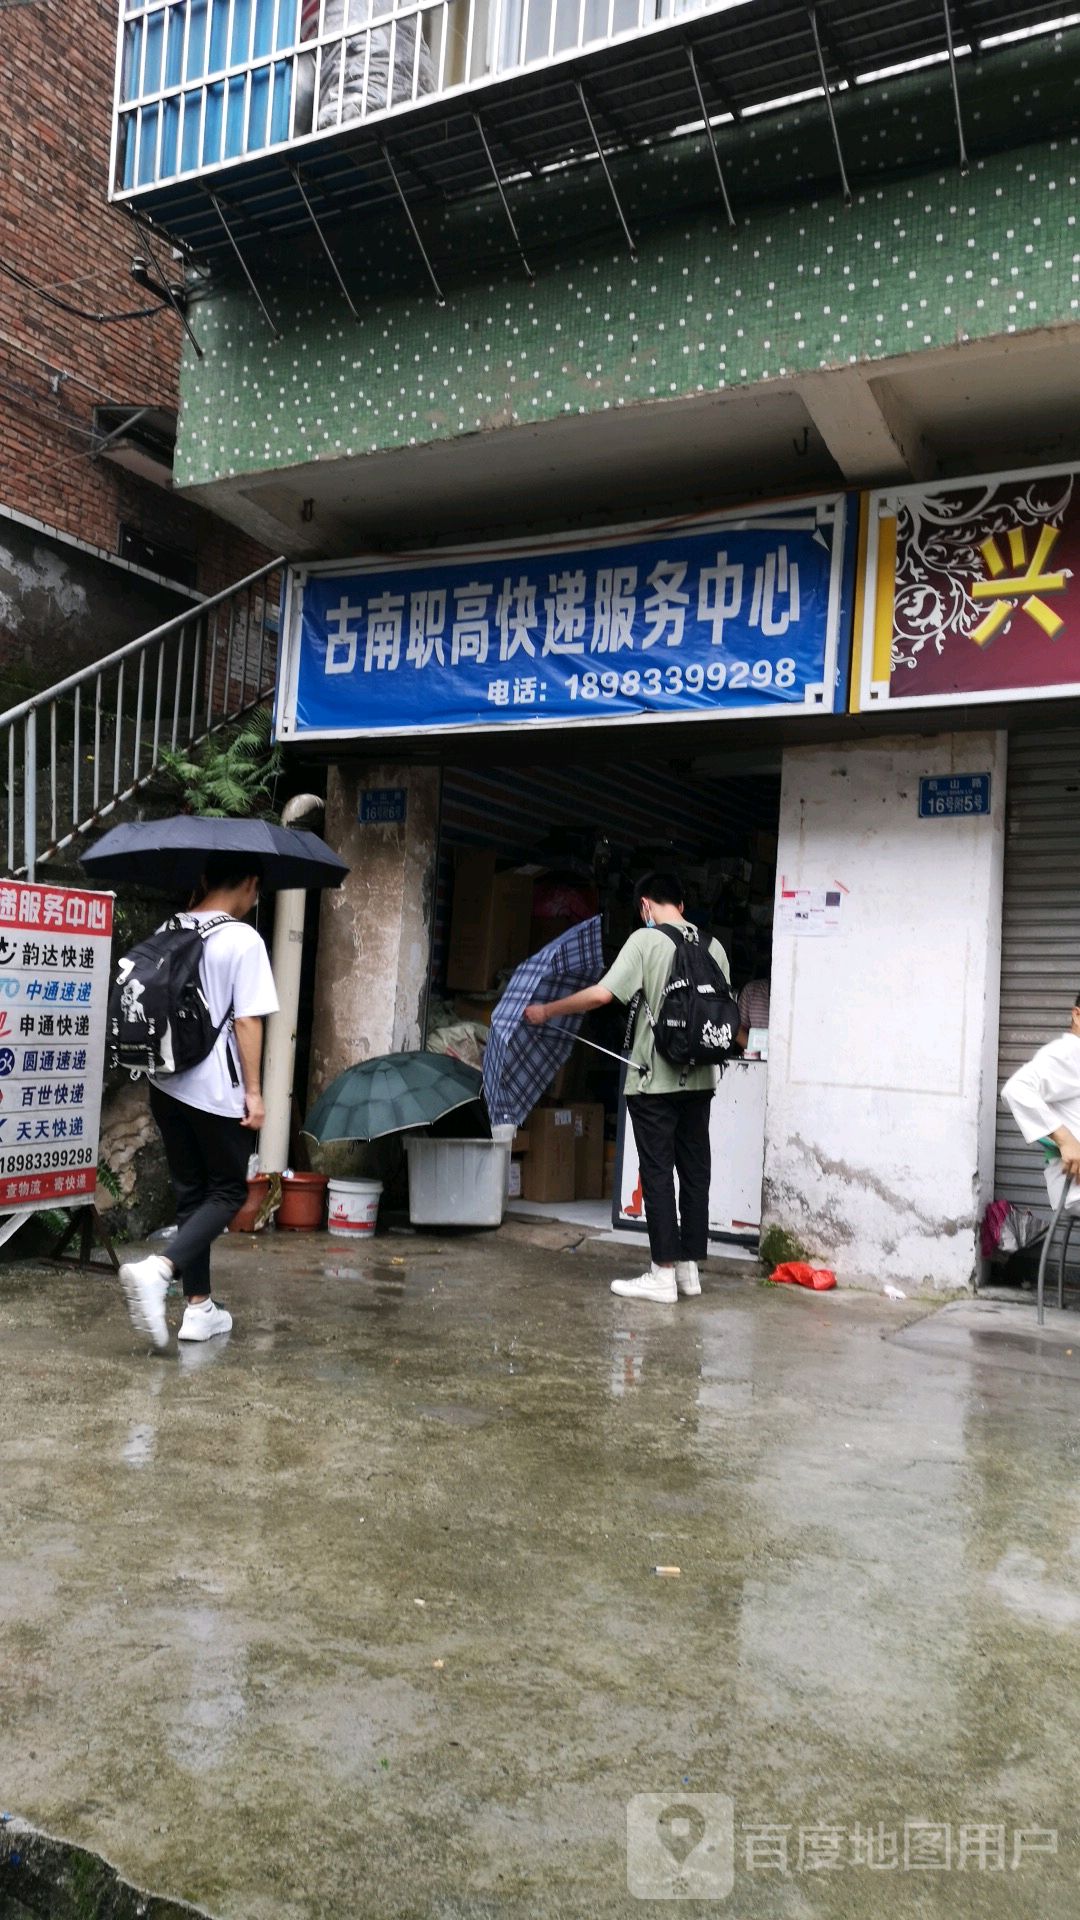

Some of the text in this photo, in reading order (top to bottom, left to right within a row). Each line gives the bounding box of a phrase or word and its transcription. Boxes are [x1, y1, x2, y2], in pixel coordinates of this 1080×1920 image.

[969, 523, 1066, 648] 兴
[325, 545, 800, 674] 古南职高快递服务中心
[564, 656, 796, 701] 18983399298
[22, 942, 94, 968] 韵达快递
[26, 980, 92, 1001] 中通速递
[20, 1014, 89, 1037] 申通快递
[23, 1050, 86, 1072] 圆通速递
[21, 1083, 84, 1106] 百世快递
[17, 1117, 83, 1140] 天天快递
[0, 1148, 92, 1174] 18983399298
